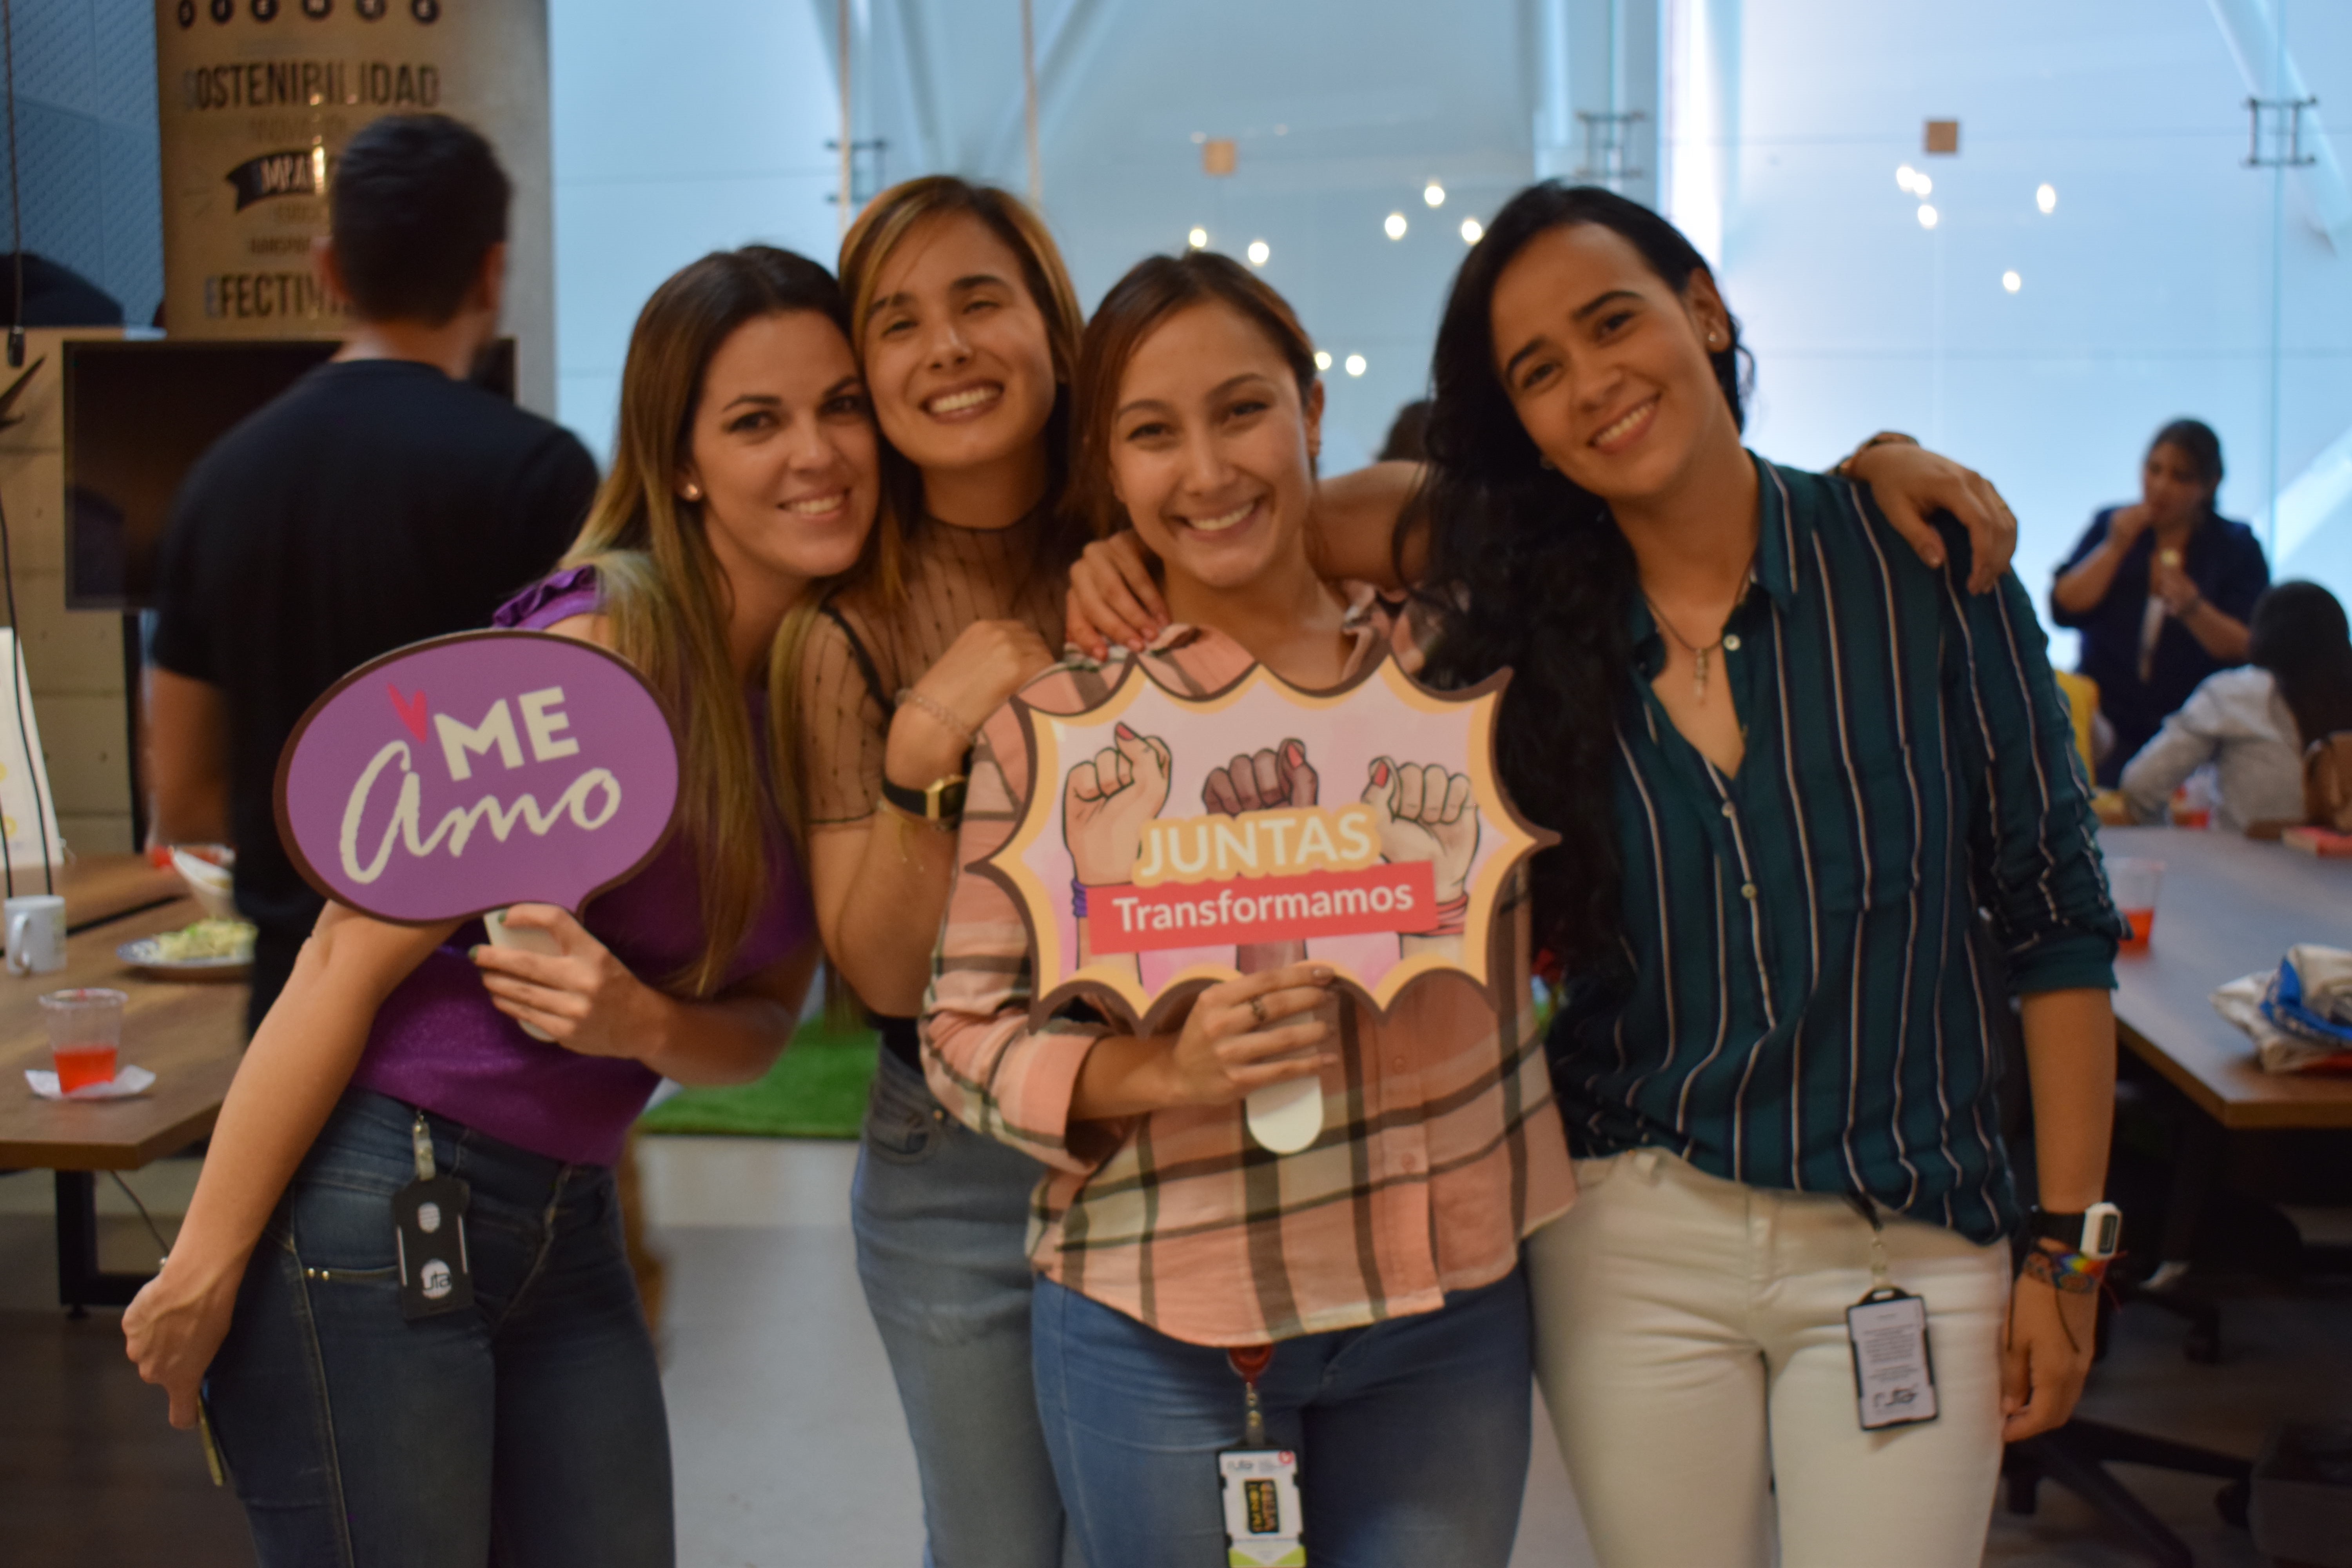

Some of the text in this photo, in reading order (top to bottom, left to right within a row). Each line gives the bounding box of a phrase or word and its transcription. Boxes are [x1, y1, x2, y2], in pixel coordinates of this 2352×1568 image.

[434, 686, 580, 781] ME
[1139, 812, 1371, 877] JUNTAS
[1112, 884, 1414, 933] Transformamos
